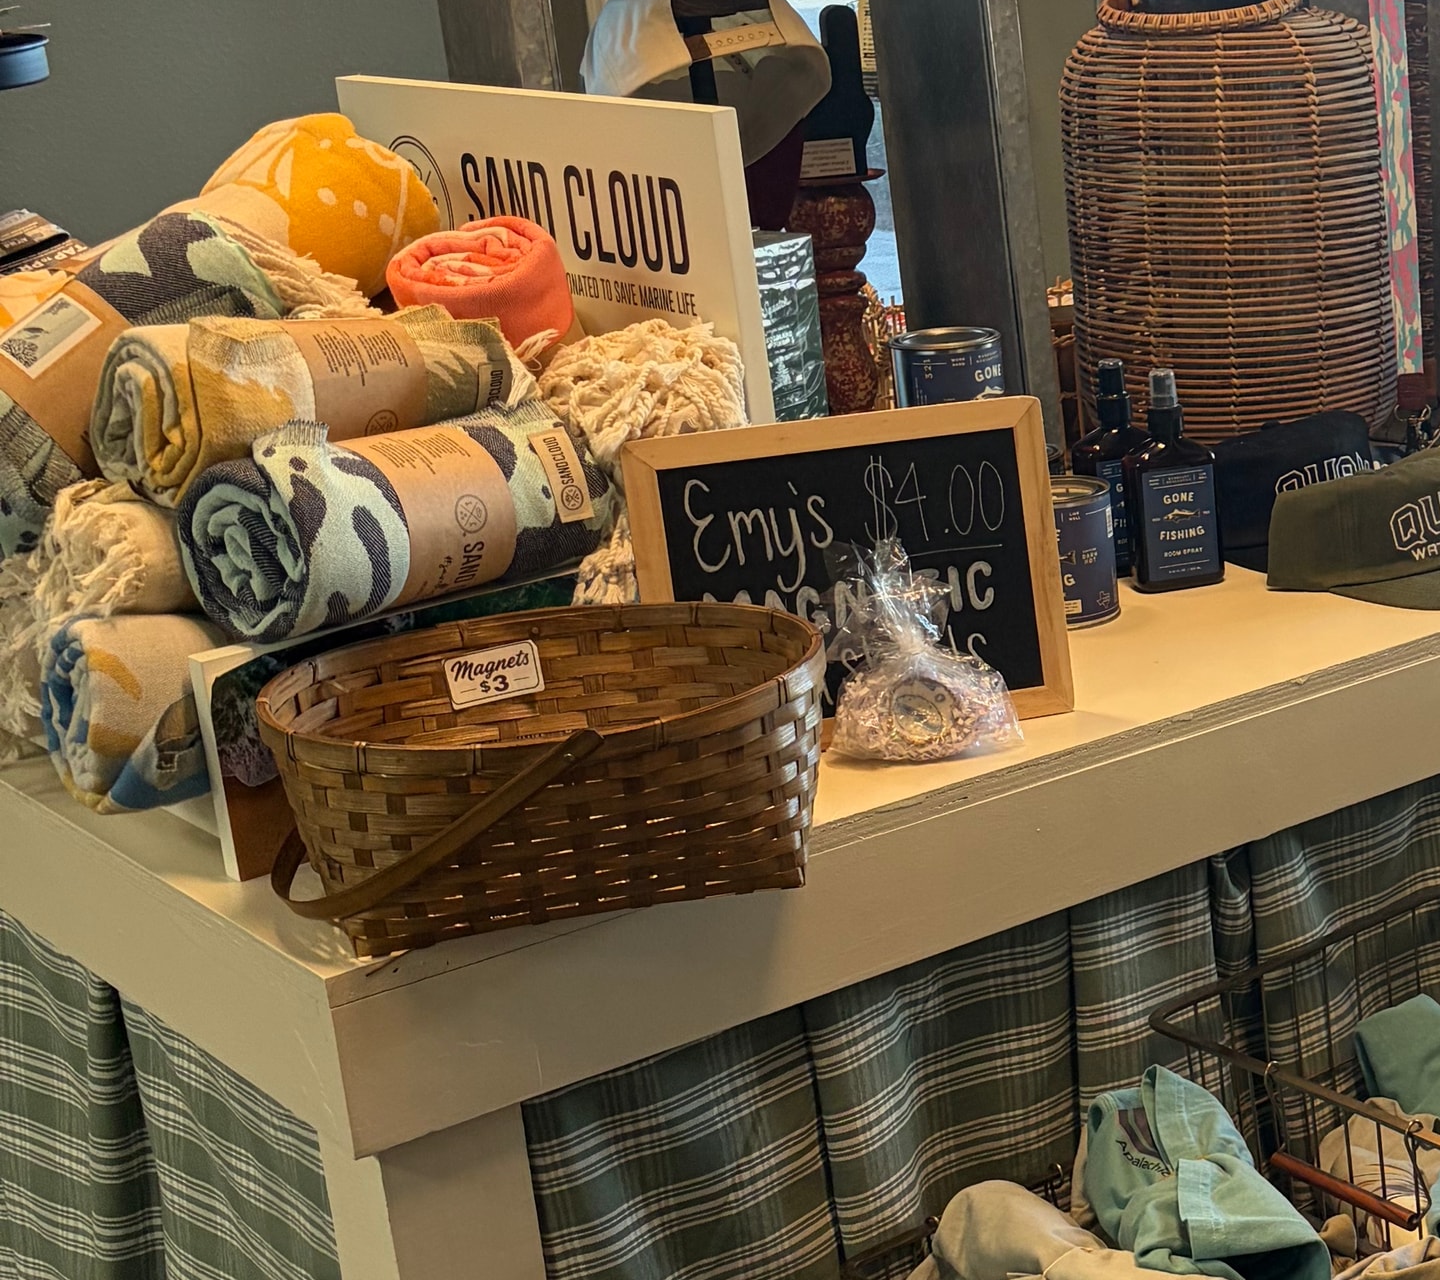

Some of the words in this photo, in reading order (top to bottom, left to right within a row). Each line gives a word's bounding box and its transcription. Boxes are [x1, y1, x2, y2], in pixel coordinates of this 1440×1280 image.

[460, 152, 557, 242] SAND
[563, 164, 691, 276] CLOUD
[566, 272, 600, 300] ONATED
[600, 277, 613, 302] TO
[613, 281, 638, 307] SAVE
[638, 285, 675, 313] MARINE
[676, 292, 698, 316] LIFE
[974, 363, 1002, 383] GONE
[1163, 492, 1195, 505] GONE
[684, 479, 834, 593] Emy's
[863, 455, 1006, 543] $4.00
[1159, 525, 1206, 541] FISHING
[454, 541, 485, 585] SAND
[1164, 548, 1182, 558] ROOM
[1182, 547, 1204, 557] SPRAY
[451, 650, 530, 682] Magnets
[480, 674, 509, 693] $3
